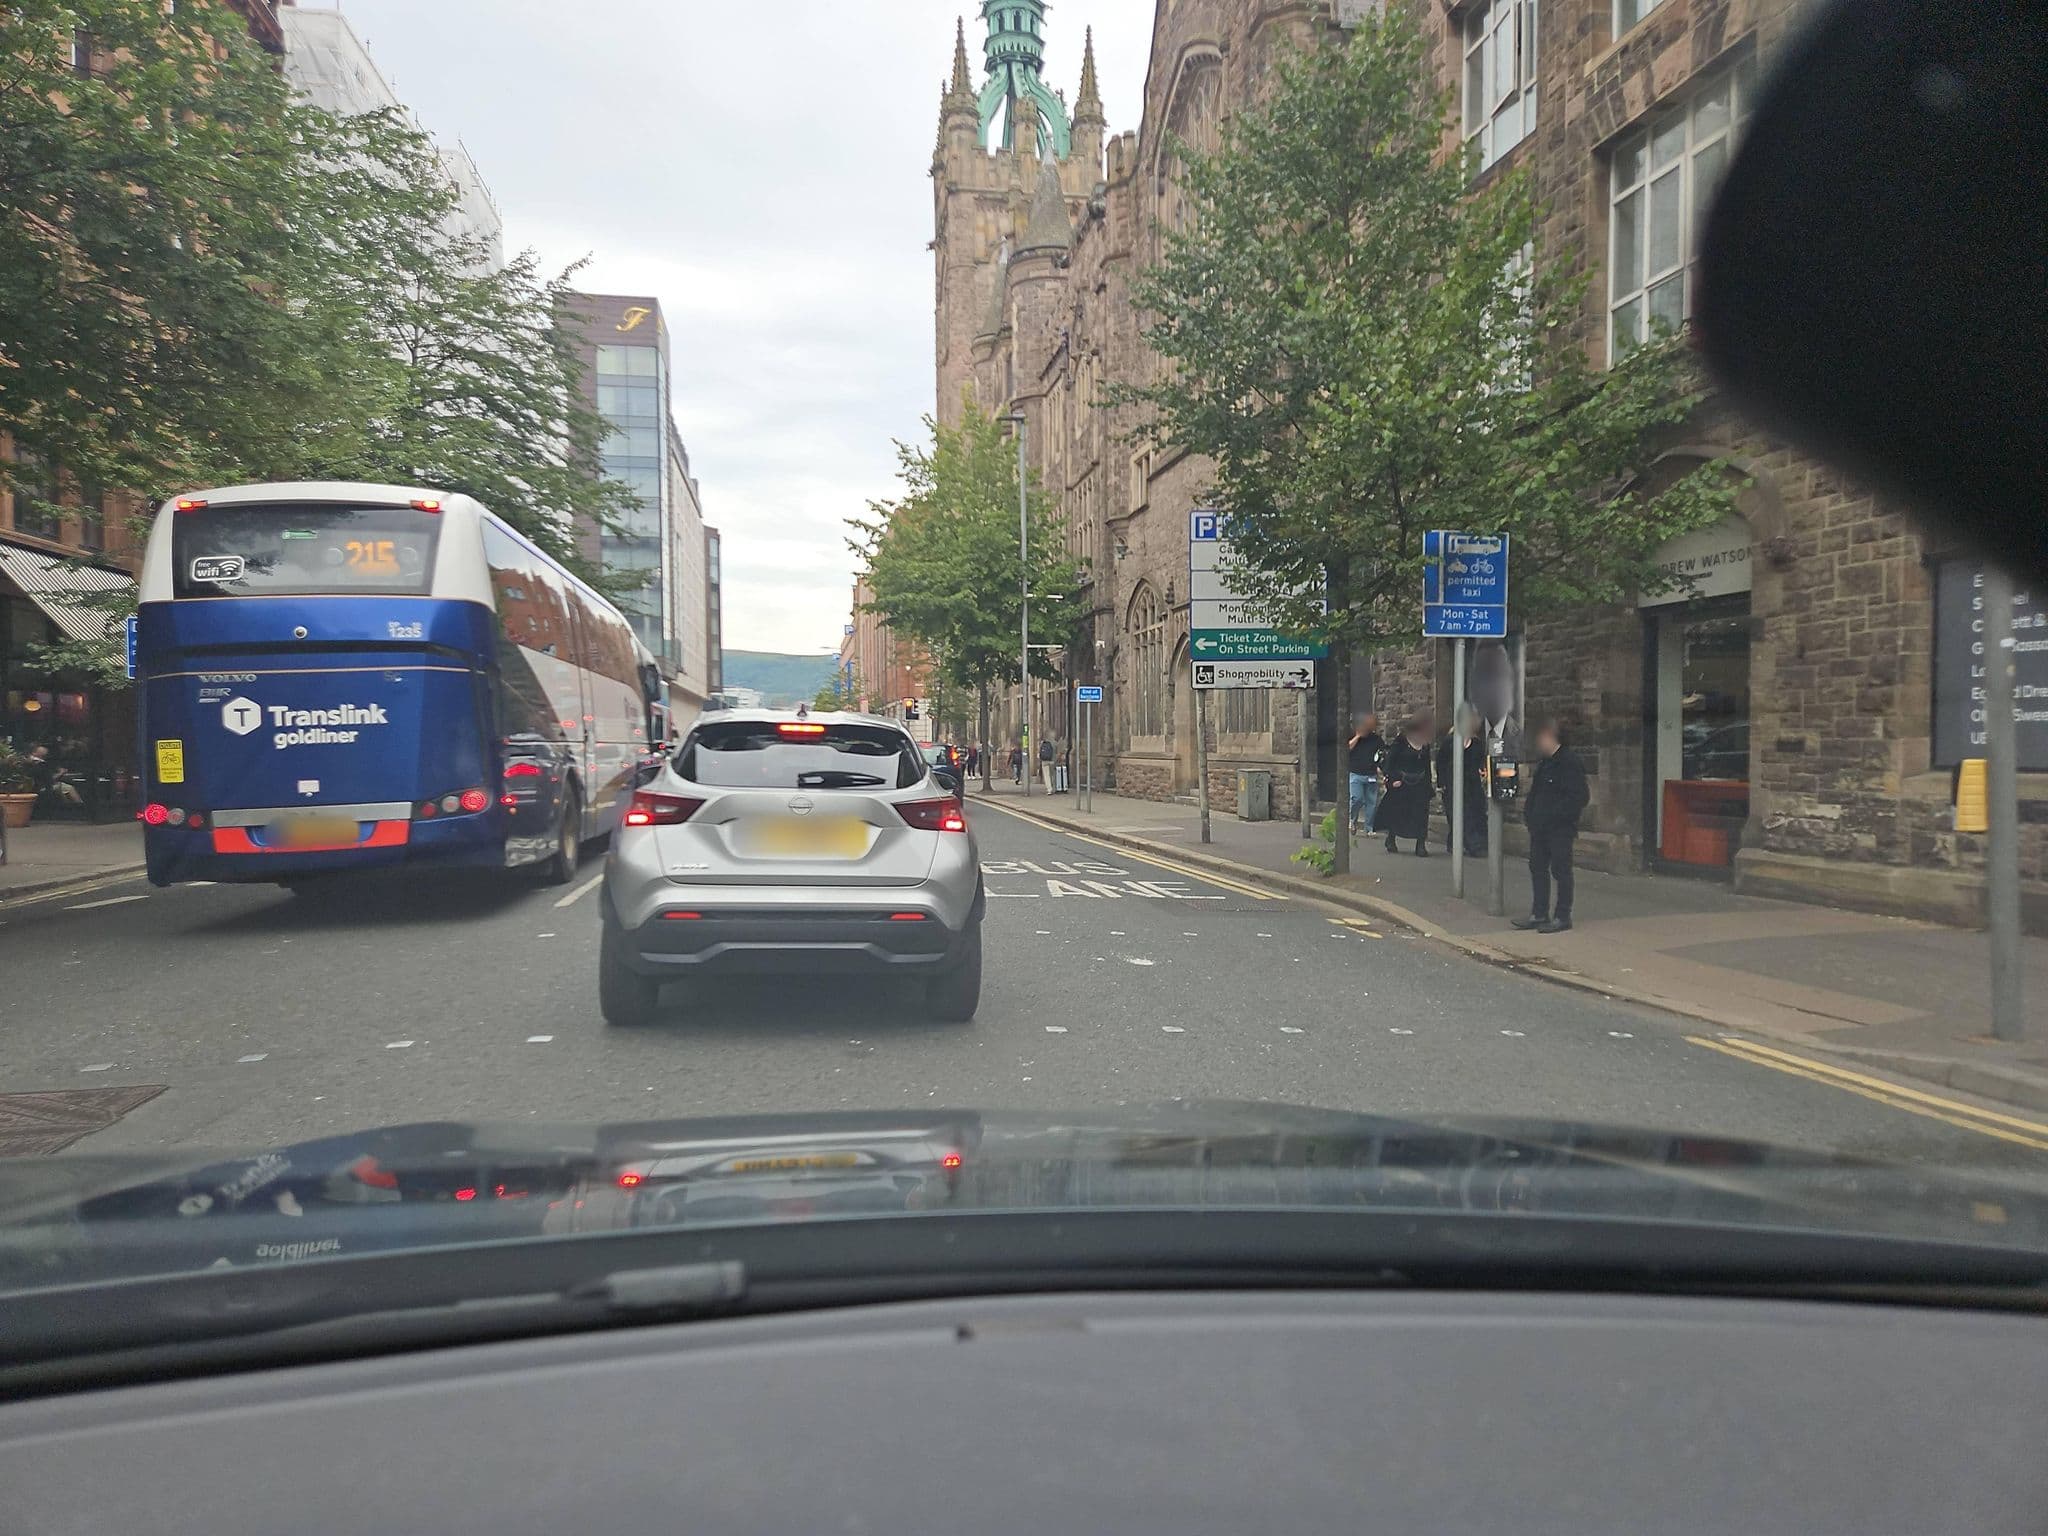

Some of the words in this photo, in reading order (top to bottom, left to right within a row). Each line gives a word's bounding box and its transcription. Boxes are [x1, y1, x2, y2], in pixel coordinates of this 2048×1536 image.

[1200, 518, 1213, 537] P
[345, 541, 395, 566] 215
[197, 567, 220, 576] wifi
[1448, 576, 1496, 585] permitted
[1462, 588, 1481, 597] taxi
[1442, 609, 1464, 619] Mon
[1471, 609, 1489, 619] Sat
[1220, 633, 1250, 643] Ticket
[1253, 633, 1278, 643] Zone
[1220, 645, 1233, 654] On
[1237, 645, 1269, 654] Street
[1272, 645, 1310, 655] Parking
[199, 674, 257, 683] VOLVO
[1218, 669, 1286, 679] Shopmobility
[268, 704, 388, 727] Translink
[273, 728, 359, 749] goldliner
[979, 861, 1129, 876] BUS
